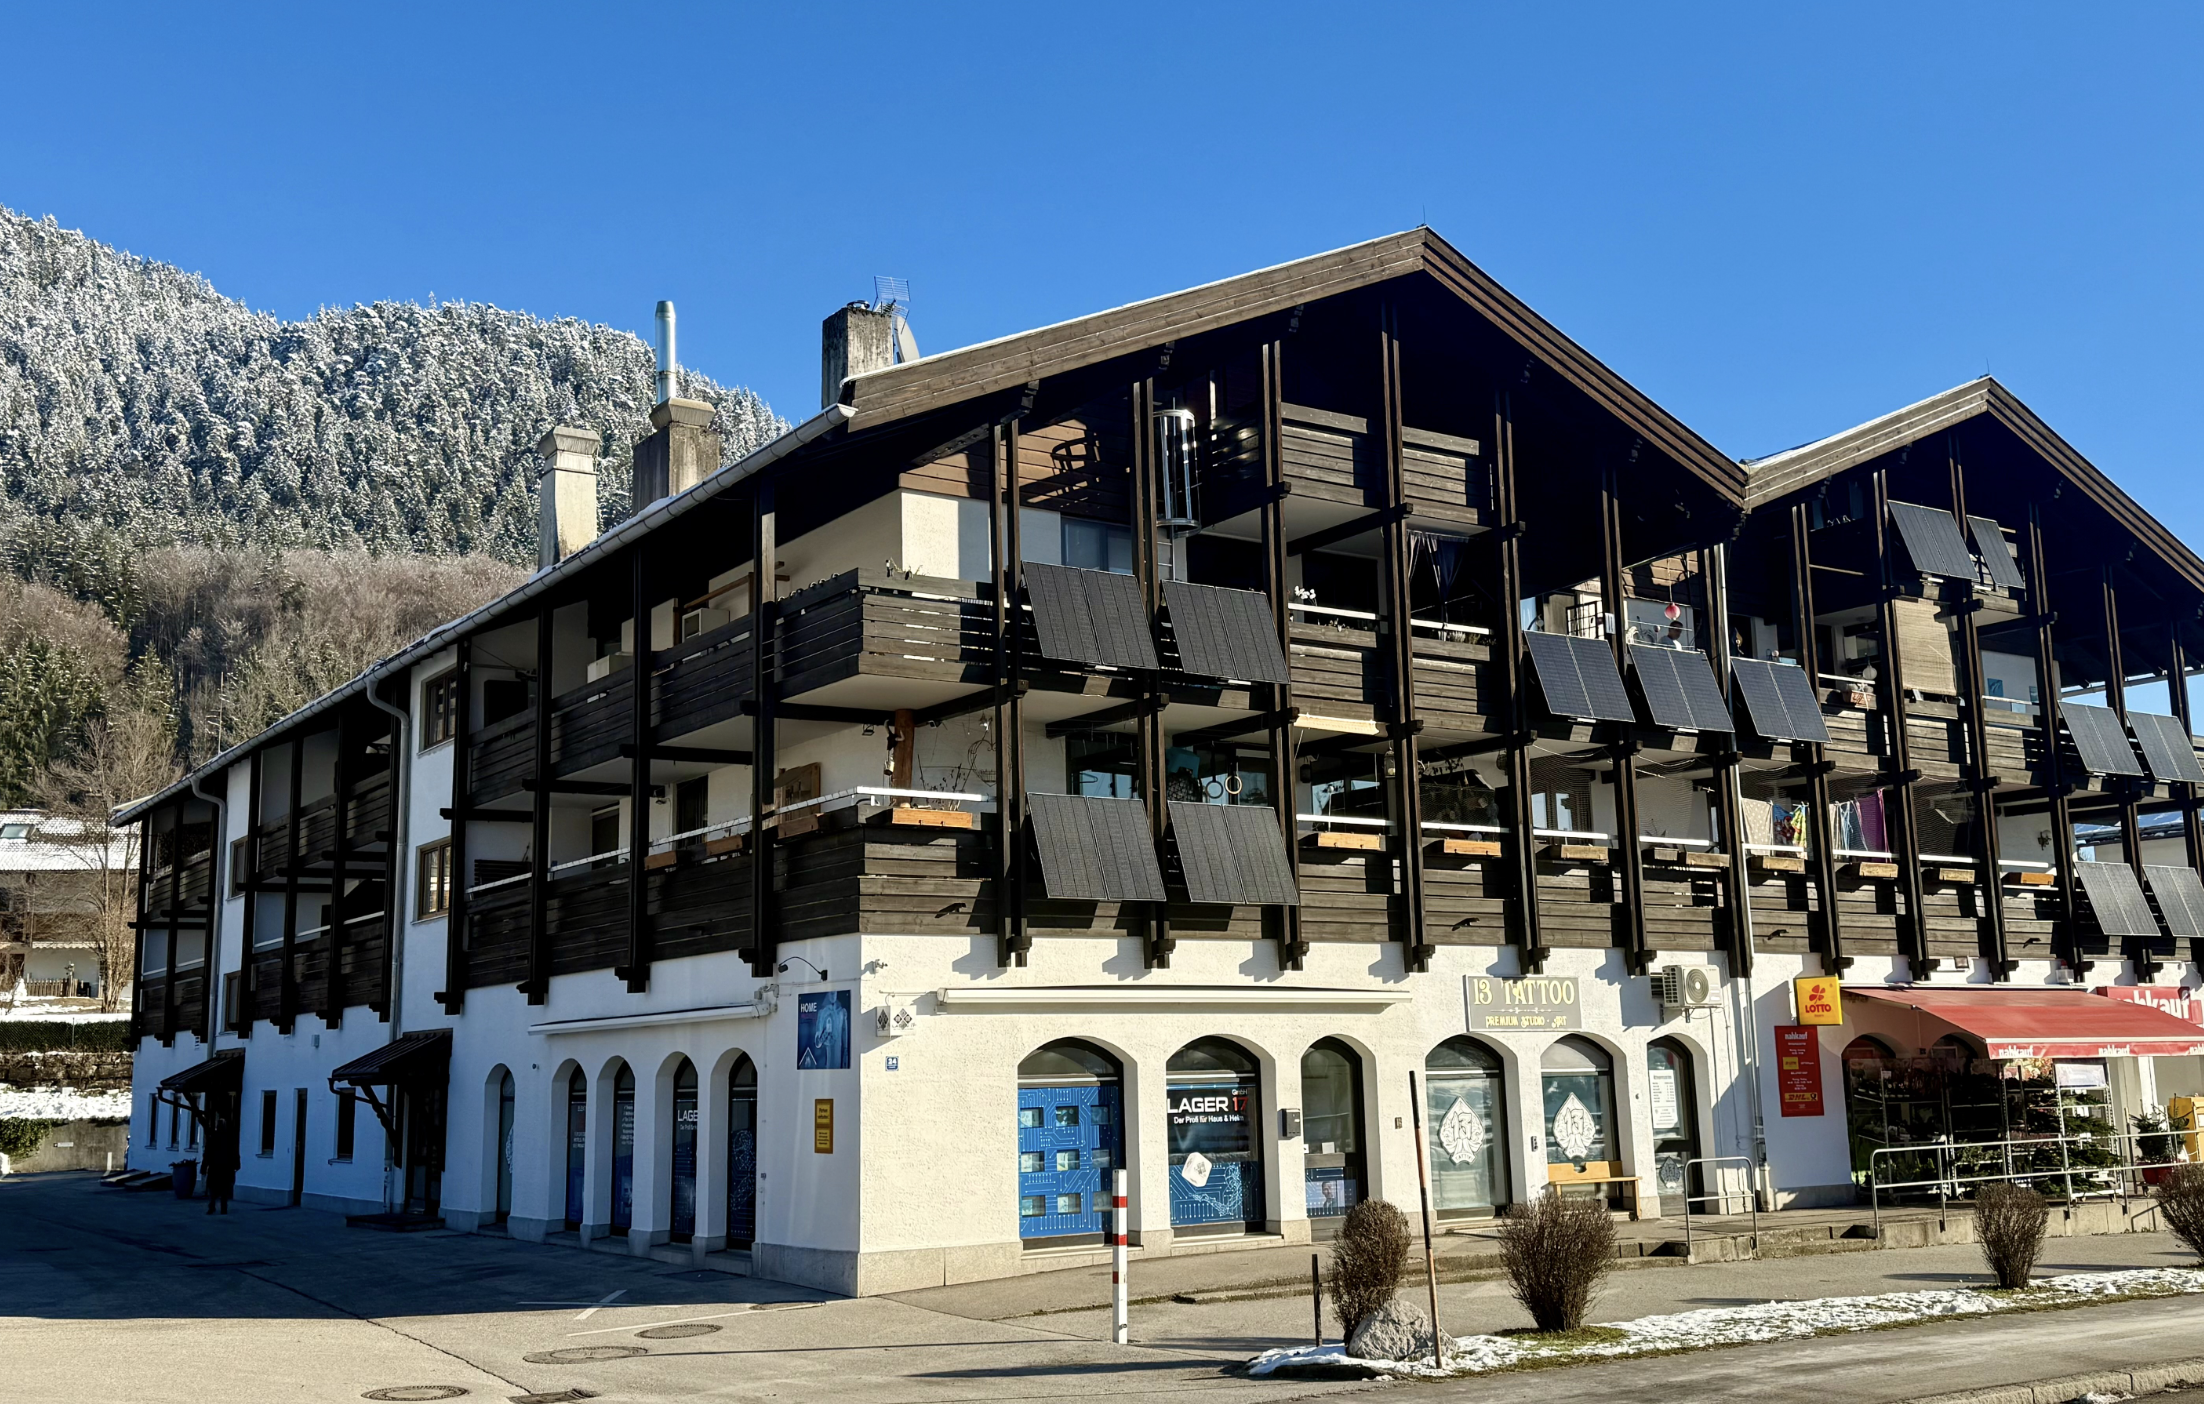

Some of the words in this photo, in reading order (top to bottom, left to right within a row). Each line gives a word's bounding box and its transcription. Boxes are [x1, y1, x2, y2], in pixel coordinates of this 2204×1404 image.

[1473, 979, 1493, 1005] 13
[1501, 979, 1575, 1005] TATTOO
[800, 1002, 817, 1012] HOME
[1805, 1004, 1831, 1013] LOTTO
[1485, 1016, 1519, 1028] PREMIUM
[1521, 1016, 1545, 1028] STUDIO
[1551, 1016, 1567, 1028] ART
[1785, 1032, 1807, 1040] nahkauf
[1998, 1045, 2033, 1057] nahkauf
[2098, 1044, 2130, 1056] nahkauf
[1167, 1096, 1229, 1113] LAGER
[1232, 1096, 1249, 1111] 17
[1174, 1116, 1185, 1124] Der
[1185, 1115, 1199, 1123] Profi
[1199, 1115, 1208, 1123] für
[1208, 1115, 1223, 1123] Haus
[1224, 1114, 1229, 1122] &
